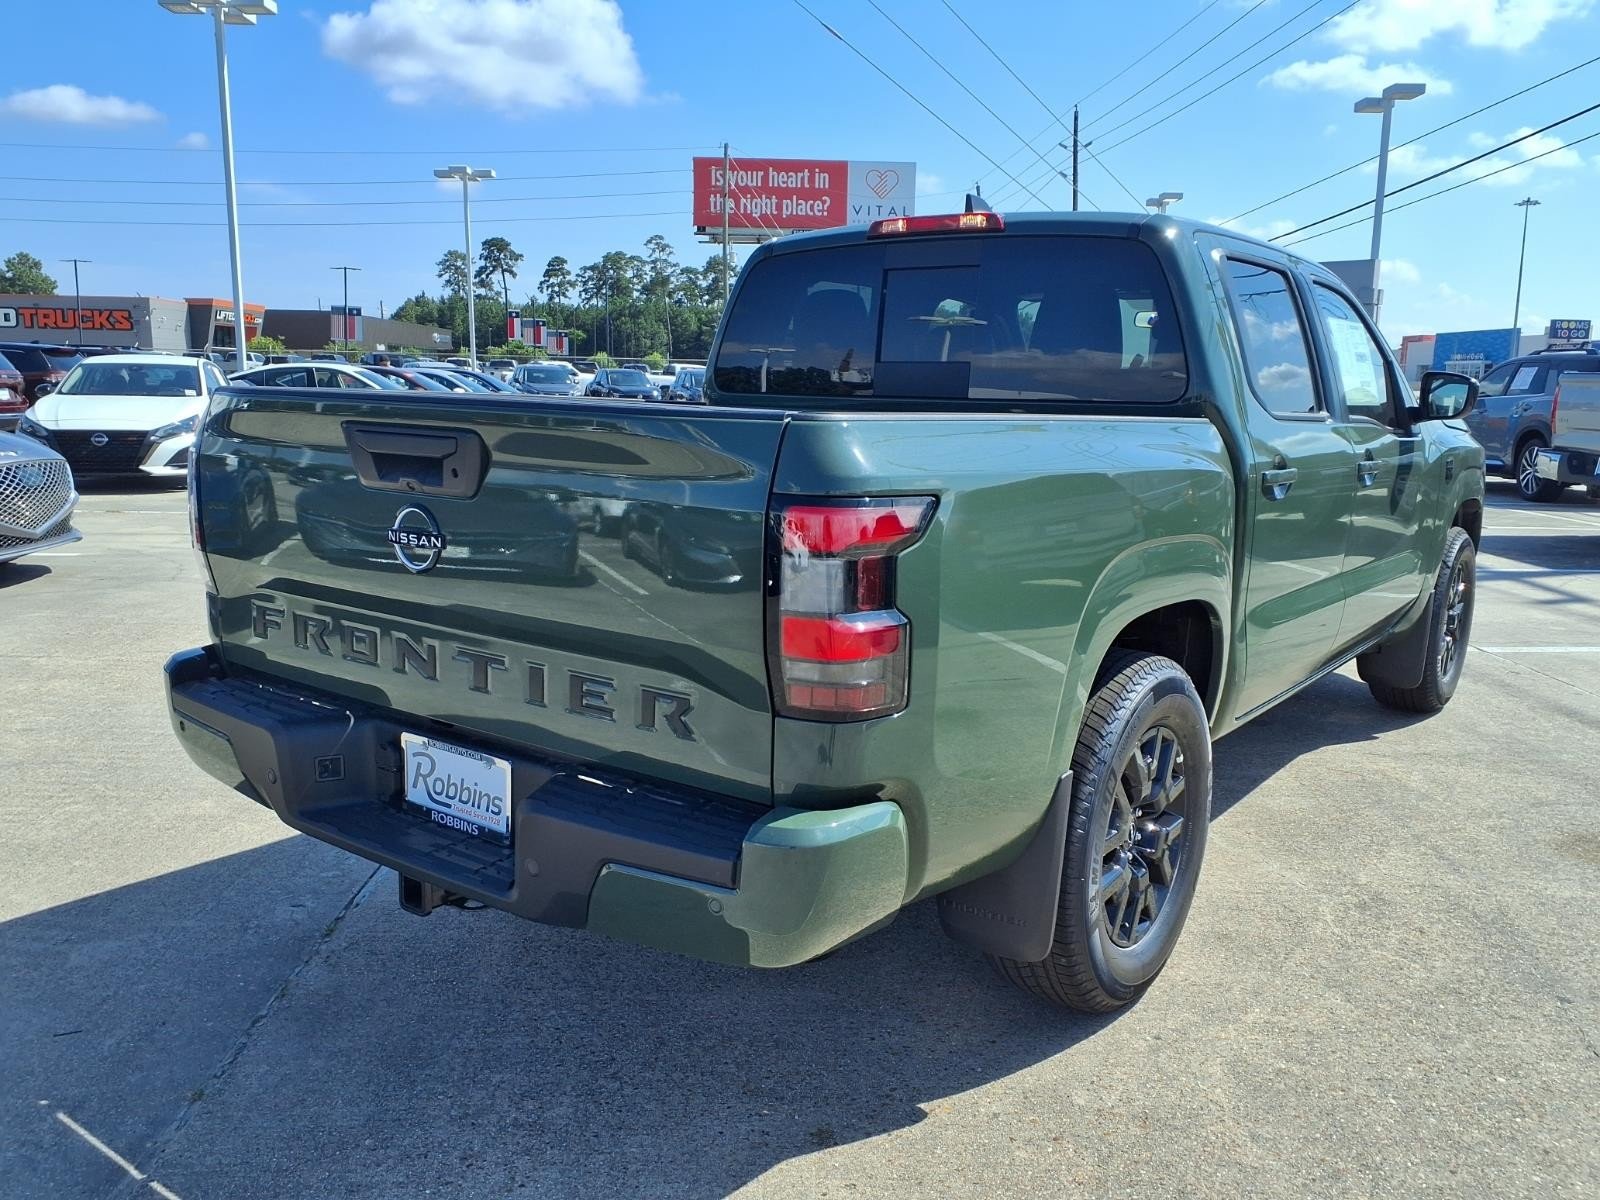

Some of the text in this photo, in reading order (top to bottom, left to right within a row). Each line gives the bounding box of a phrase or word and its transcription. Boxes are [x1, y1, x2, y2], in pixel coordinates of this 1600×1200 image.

[711, 166, 830, 190] Is your heart in
[740, 194, 778, 217] right
[782, 194, 831, 218] place?
[852, 204, 910, 218] VITAL
[19, 307, 133, 330] TRUCKS
[1555, 320, 1590, 329] ROOMS
[1557, 329, 1586, 338] TO GO
[388, 530, 442, 548] NISSAN
[251, 599, 697, 741] FRONTIER
[411, 751, 503, 816] Robbins
[431, 810, 479, 835] ROBBINS
